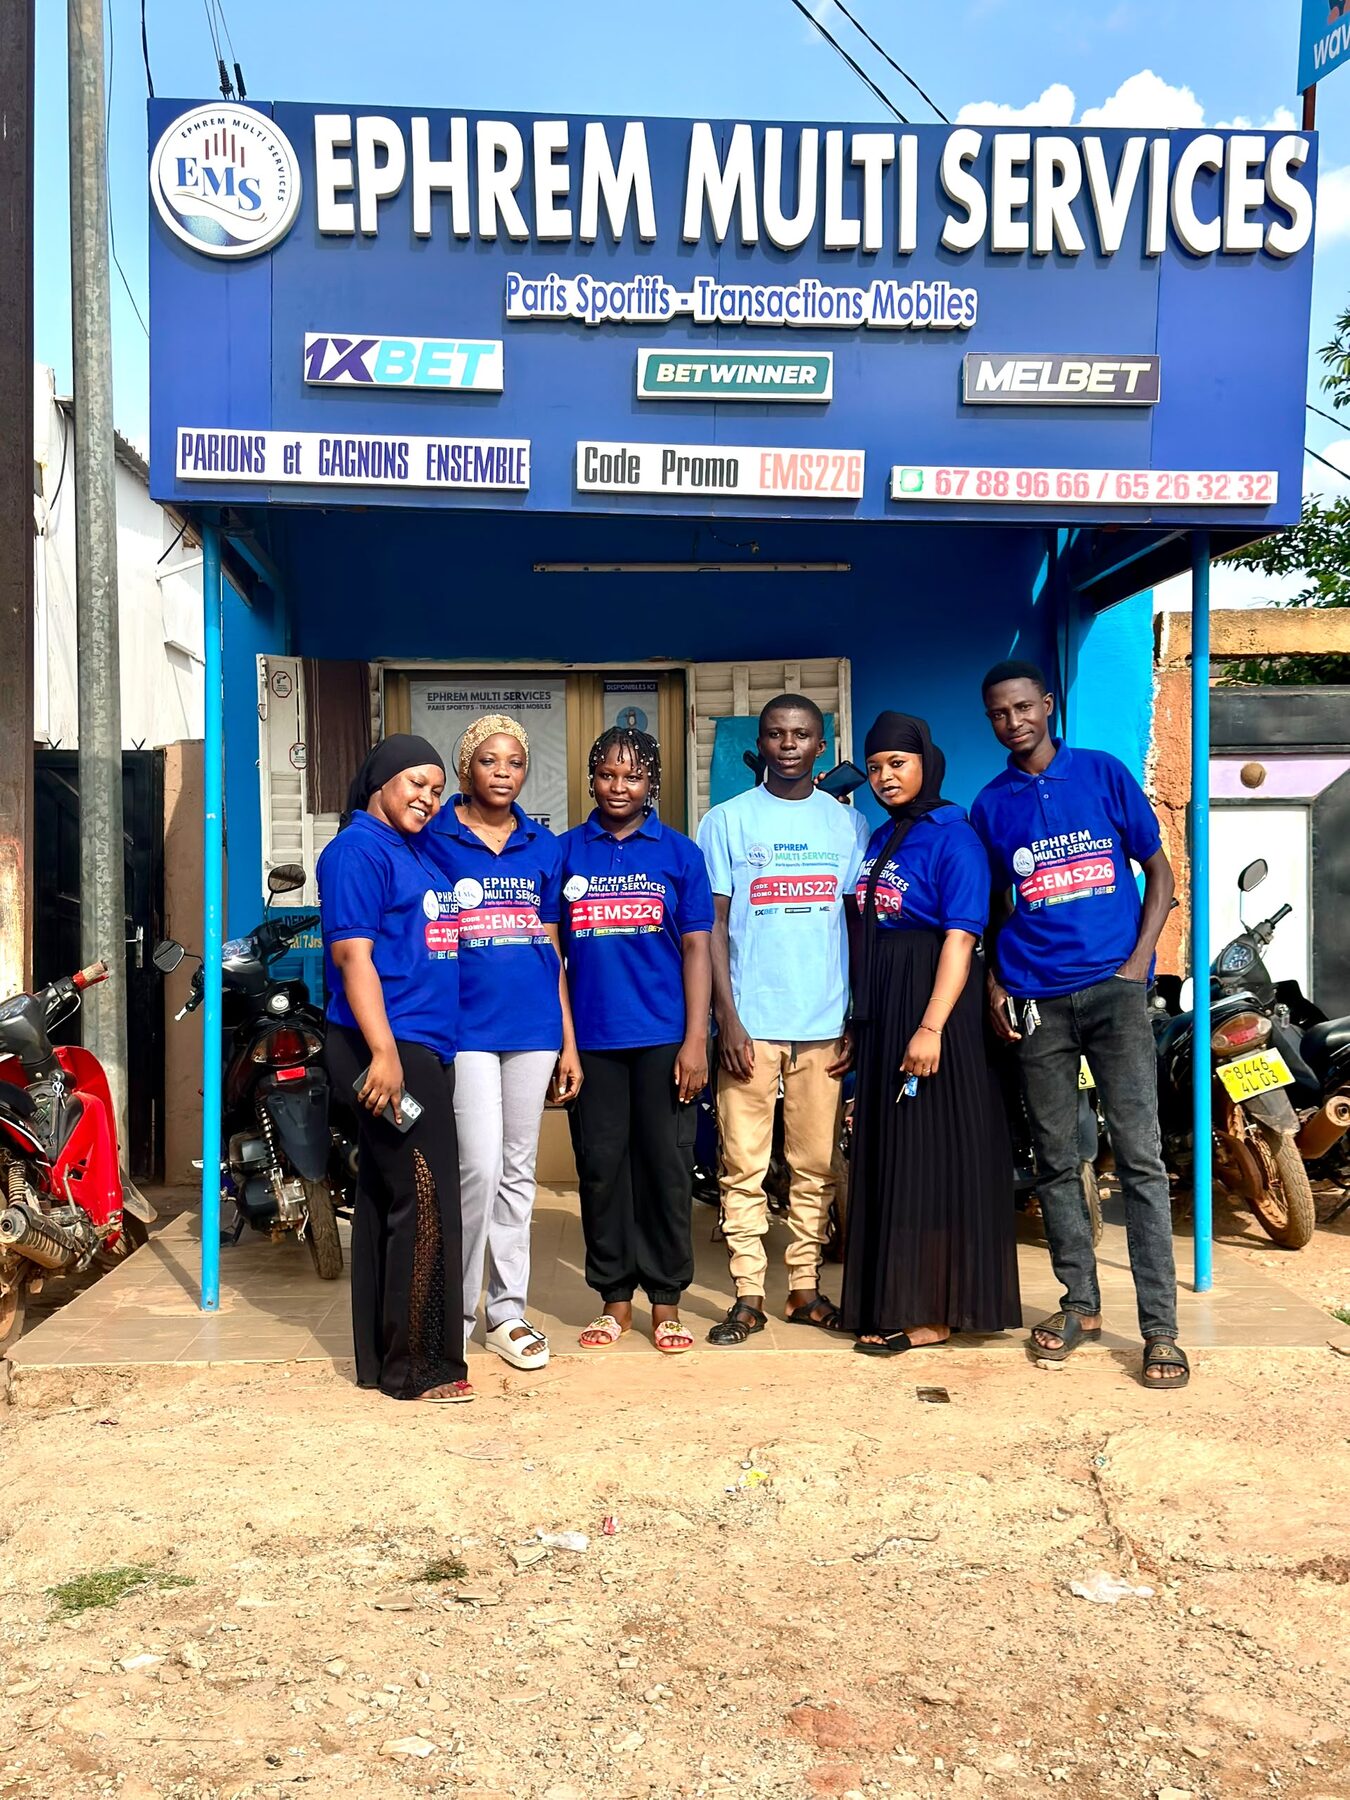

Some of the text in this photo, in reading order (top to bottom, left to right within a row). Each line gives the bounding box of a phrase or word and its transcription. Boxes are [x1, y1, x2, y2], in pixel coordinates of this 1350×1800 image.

[181, 117, 286, 202] EPHREM MULTI SERVICES
[175, 157, 262, 211] EMS
[314, 114, 1312, 258] EPHREM MULTI SERVICES
[507, 275, 567, 312] Paris
[576, 276, 670, 321] Sportifs
[699, 281, 863, 319] Transactions
[872, 284, 975, 320] Mobiles
[306, 338, 495, 386] 1XBET
[656, 363, 817, 385] BETWINNER
[975, 361, 1151, 393] MELBET
[181, 432, 526, 485] PARIONS et GAGNONS ENSEMBLE
[584, 446, 860, 492] Code Promo EMS226
[935, 469, 970, 496] 67
[976, 470, 1009, 497] 88
[1016, 471, 1049, 498] 96
[1056, 472, 1090, 499] 66
[1115, 472, 1149, 499] 65
[1155, 473, 1190, 500] 26
[1197, 474, 1231, 500] 32
[1237, 474, 1272, 500] 32
[427, 691, 551, 702] EPHREM MULTI SERVICES
[774, 843, 808, 851] EPHREM
[1031, 830, 1091, 852] EPHREM
[1033, 847, 1065, 862] MULTI
[1067, 838, 1113, 855] SERVICES
[775, 852, 839, 861] MULTI SERVICES
[483, 877, 535, 891] EPHREM
[588, 884, 619, 892] MULTI
[621, 882, 666, 894] SERVICES
[591, 874, 647, 884] EPHREM
[484, 889, 513, 900] MULTI
[1233, 1057, 1269, 1079] 8446
